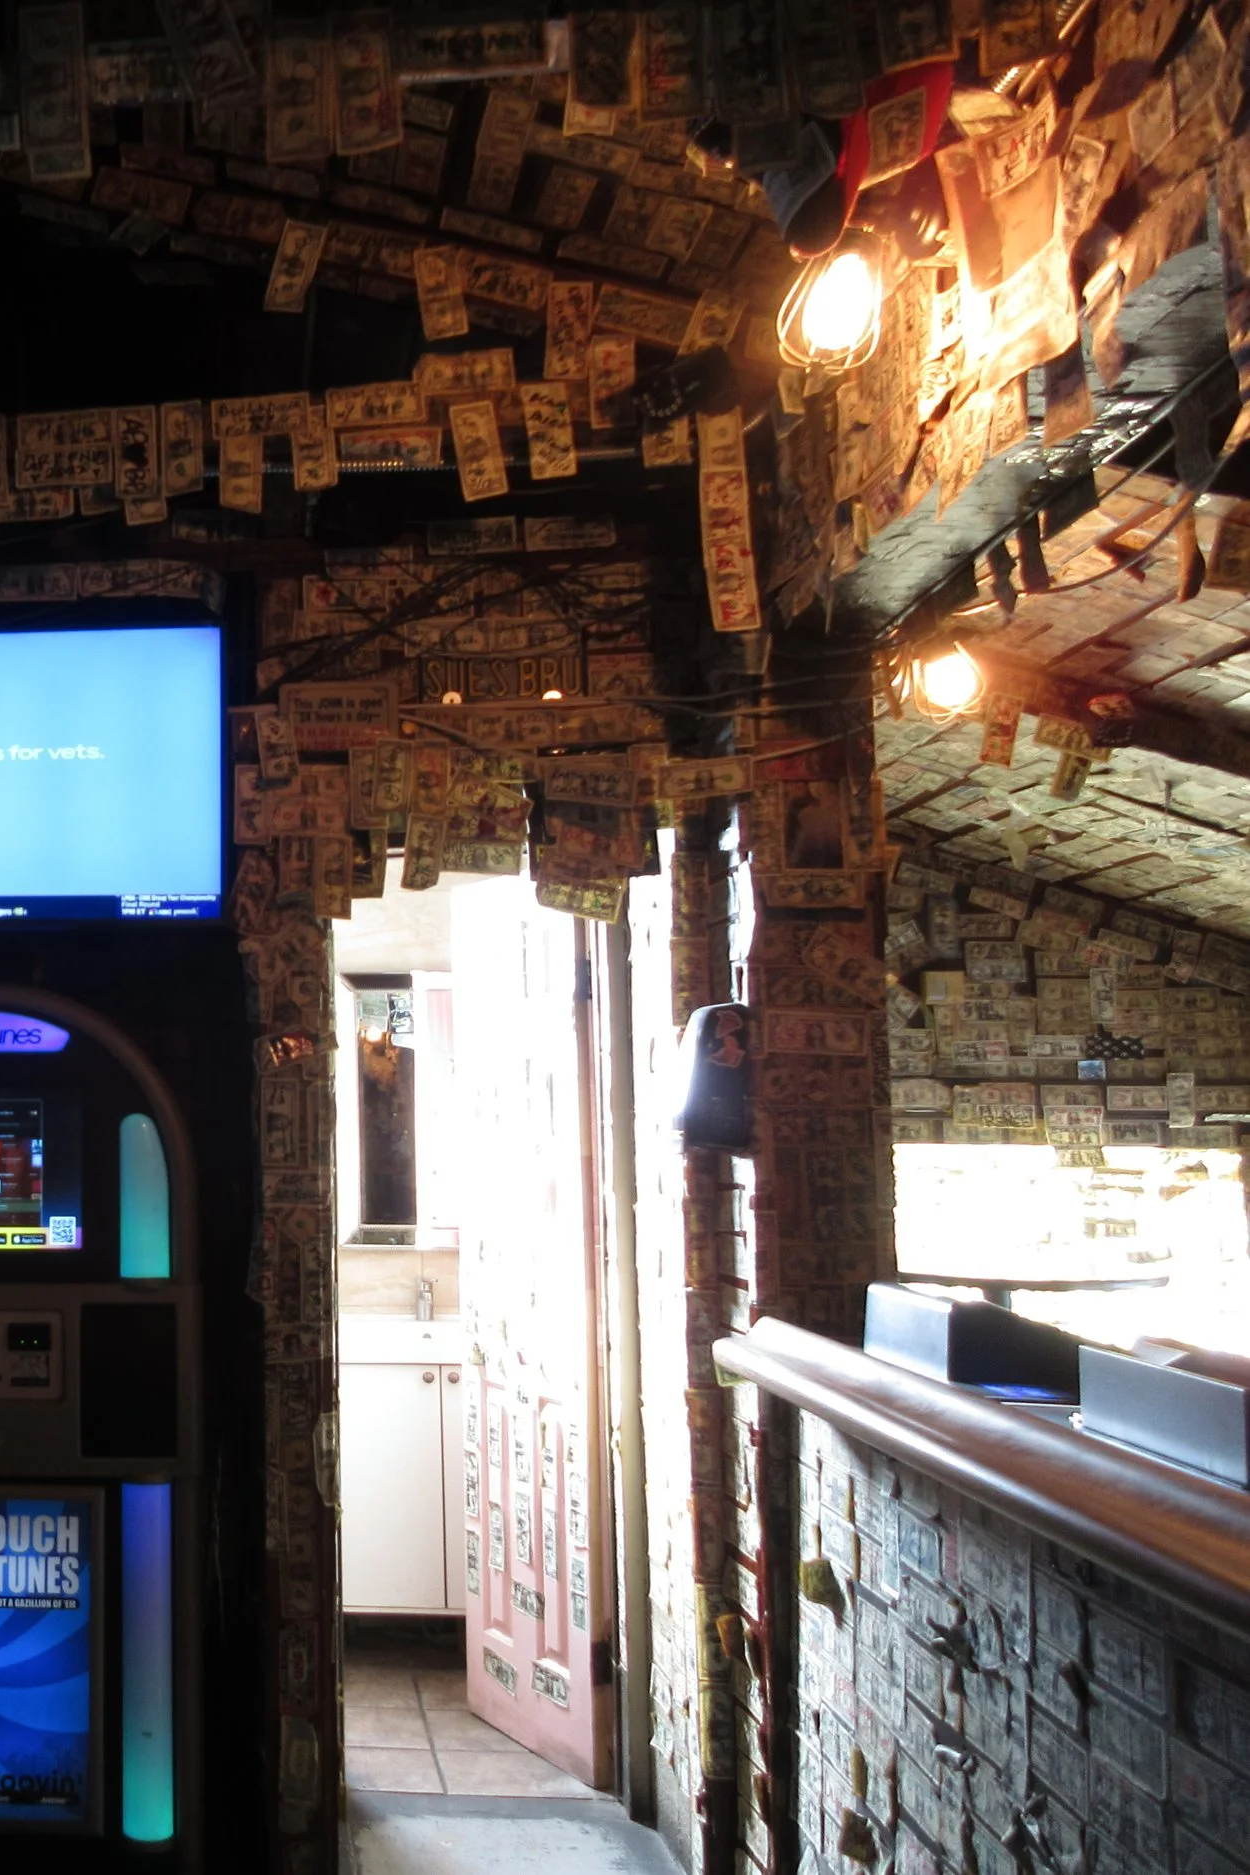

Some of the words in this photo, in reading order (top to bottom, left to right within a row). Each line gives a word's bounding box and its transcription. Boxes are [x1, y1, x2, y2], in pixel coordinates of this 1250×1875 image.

[318, 697, 343, 709] JOHN
[347, 697, 355, 708] is
[359, 697, 383, 711] open
[316, 710, 341, 722] hours
[8, 744, 43, 761] for
[48, 743, 105, 761] vets.
[14, 1598, 52, 1609] GAZILLION
[53, 1599, 62, 1609] OF
